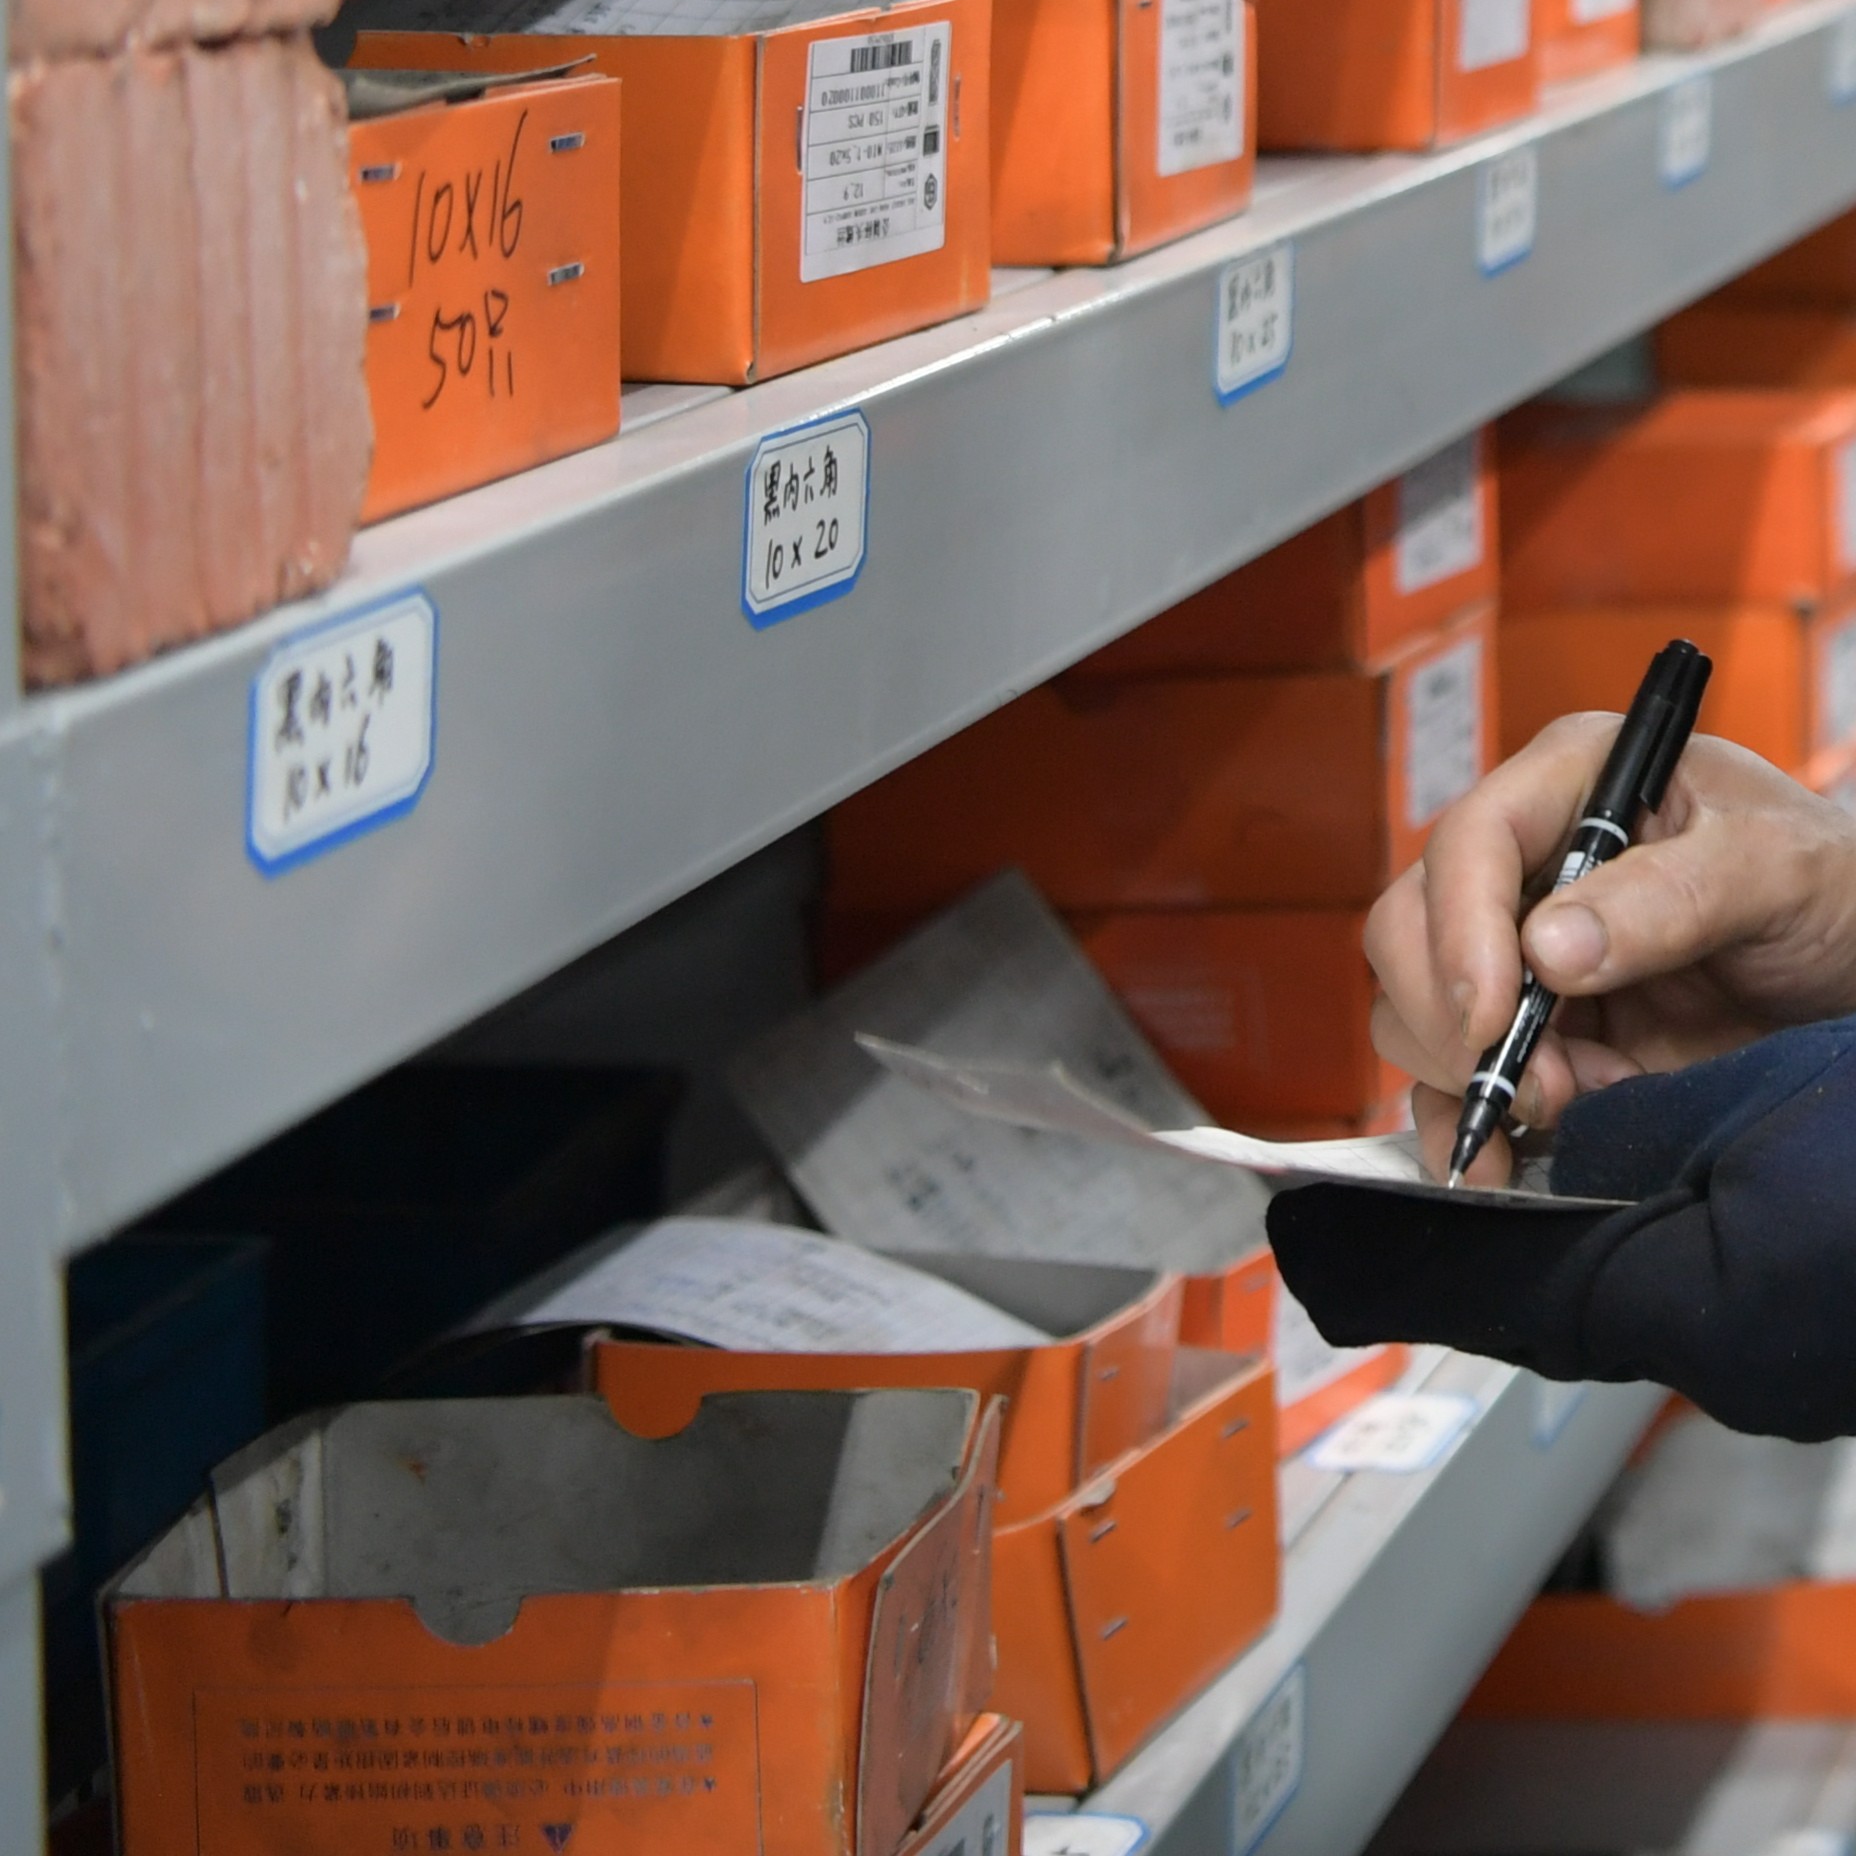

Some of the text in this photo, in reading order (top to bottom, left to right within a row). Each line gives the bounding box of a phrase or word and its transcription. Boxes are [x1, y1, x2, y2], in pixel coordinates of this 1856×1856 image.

[843, 181, 865, 200] 12.9
[763, 445, 839, 526] 黑内六角
[274, 635, 395, 753] 黑内六角
[390, 1824, 522, 1853] 注意事项
